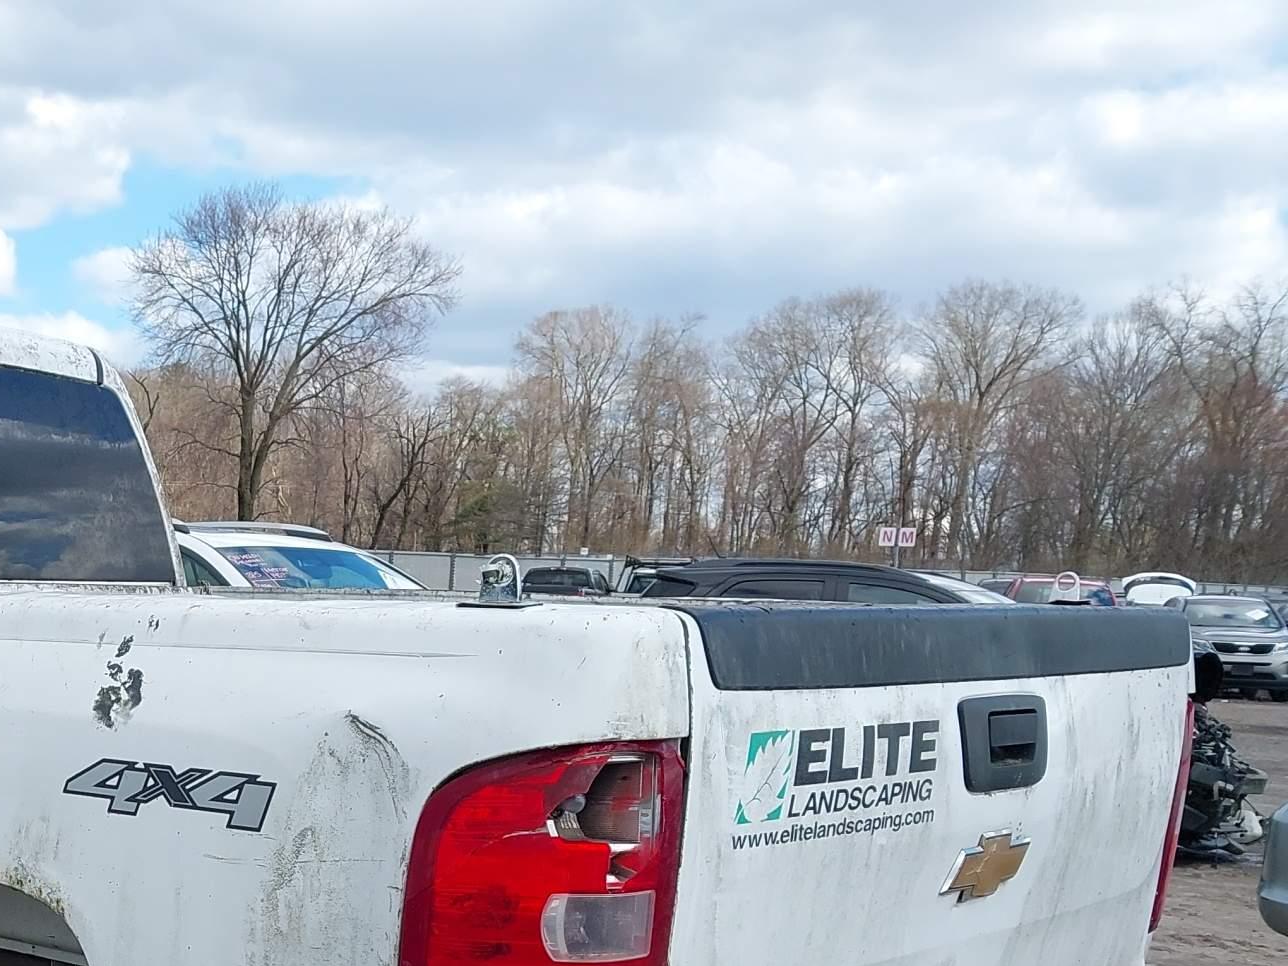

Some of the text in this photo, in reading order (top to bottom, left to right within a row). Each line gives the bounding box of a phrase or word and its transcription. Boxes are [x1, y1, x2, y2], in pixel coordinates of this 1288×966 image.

[883, 530, 893, 543] N
[902, 531, 913, 543] M
[793, 720, 939, 786] ELITE
[787, 779, 932, 818] LANDSCAPING
[732, 809, 934, 850] www.elitelandscaping.com
